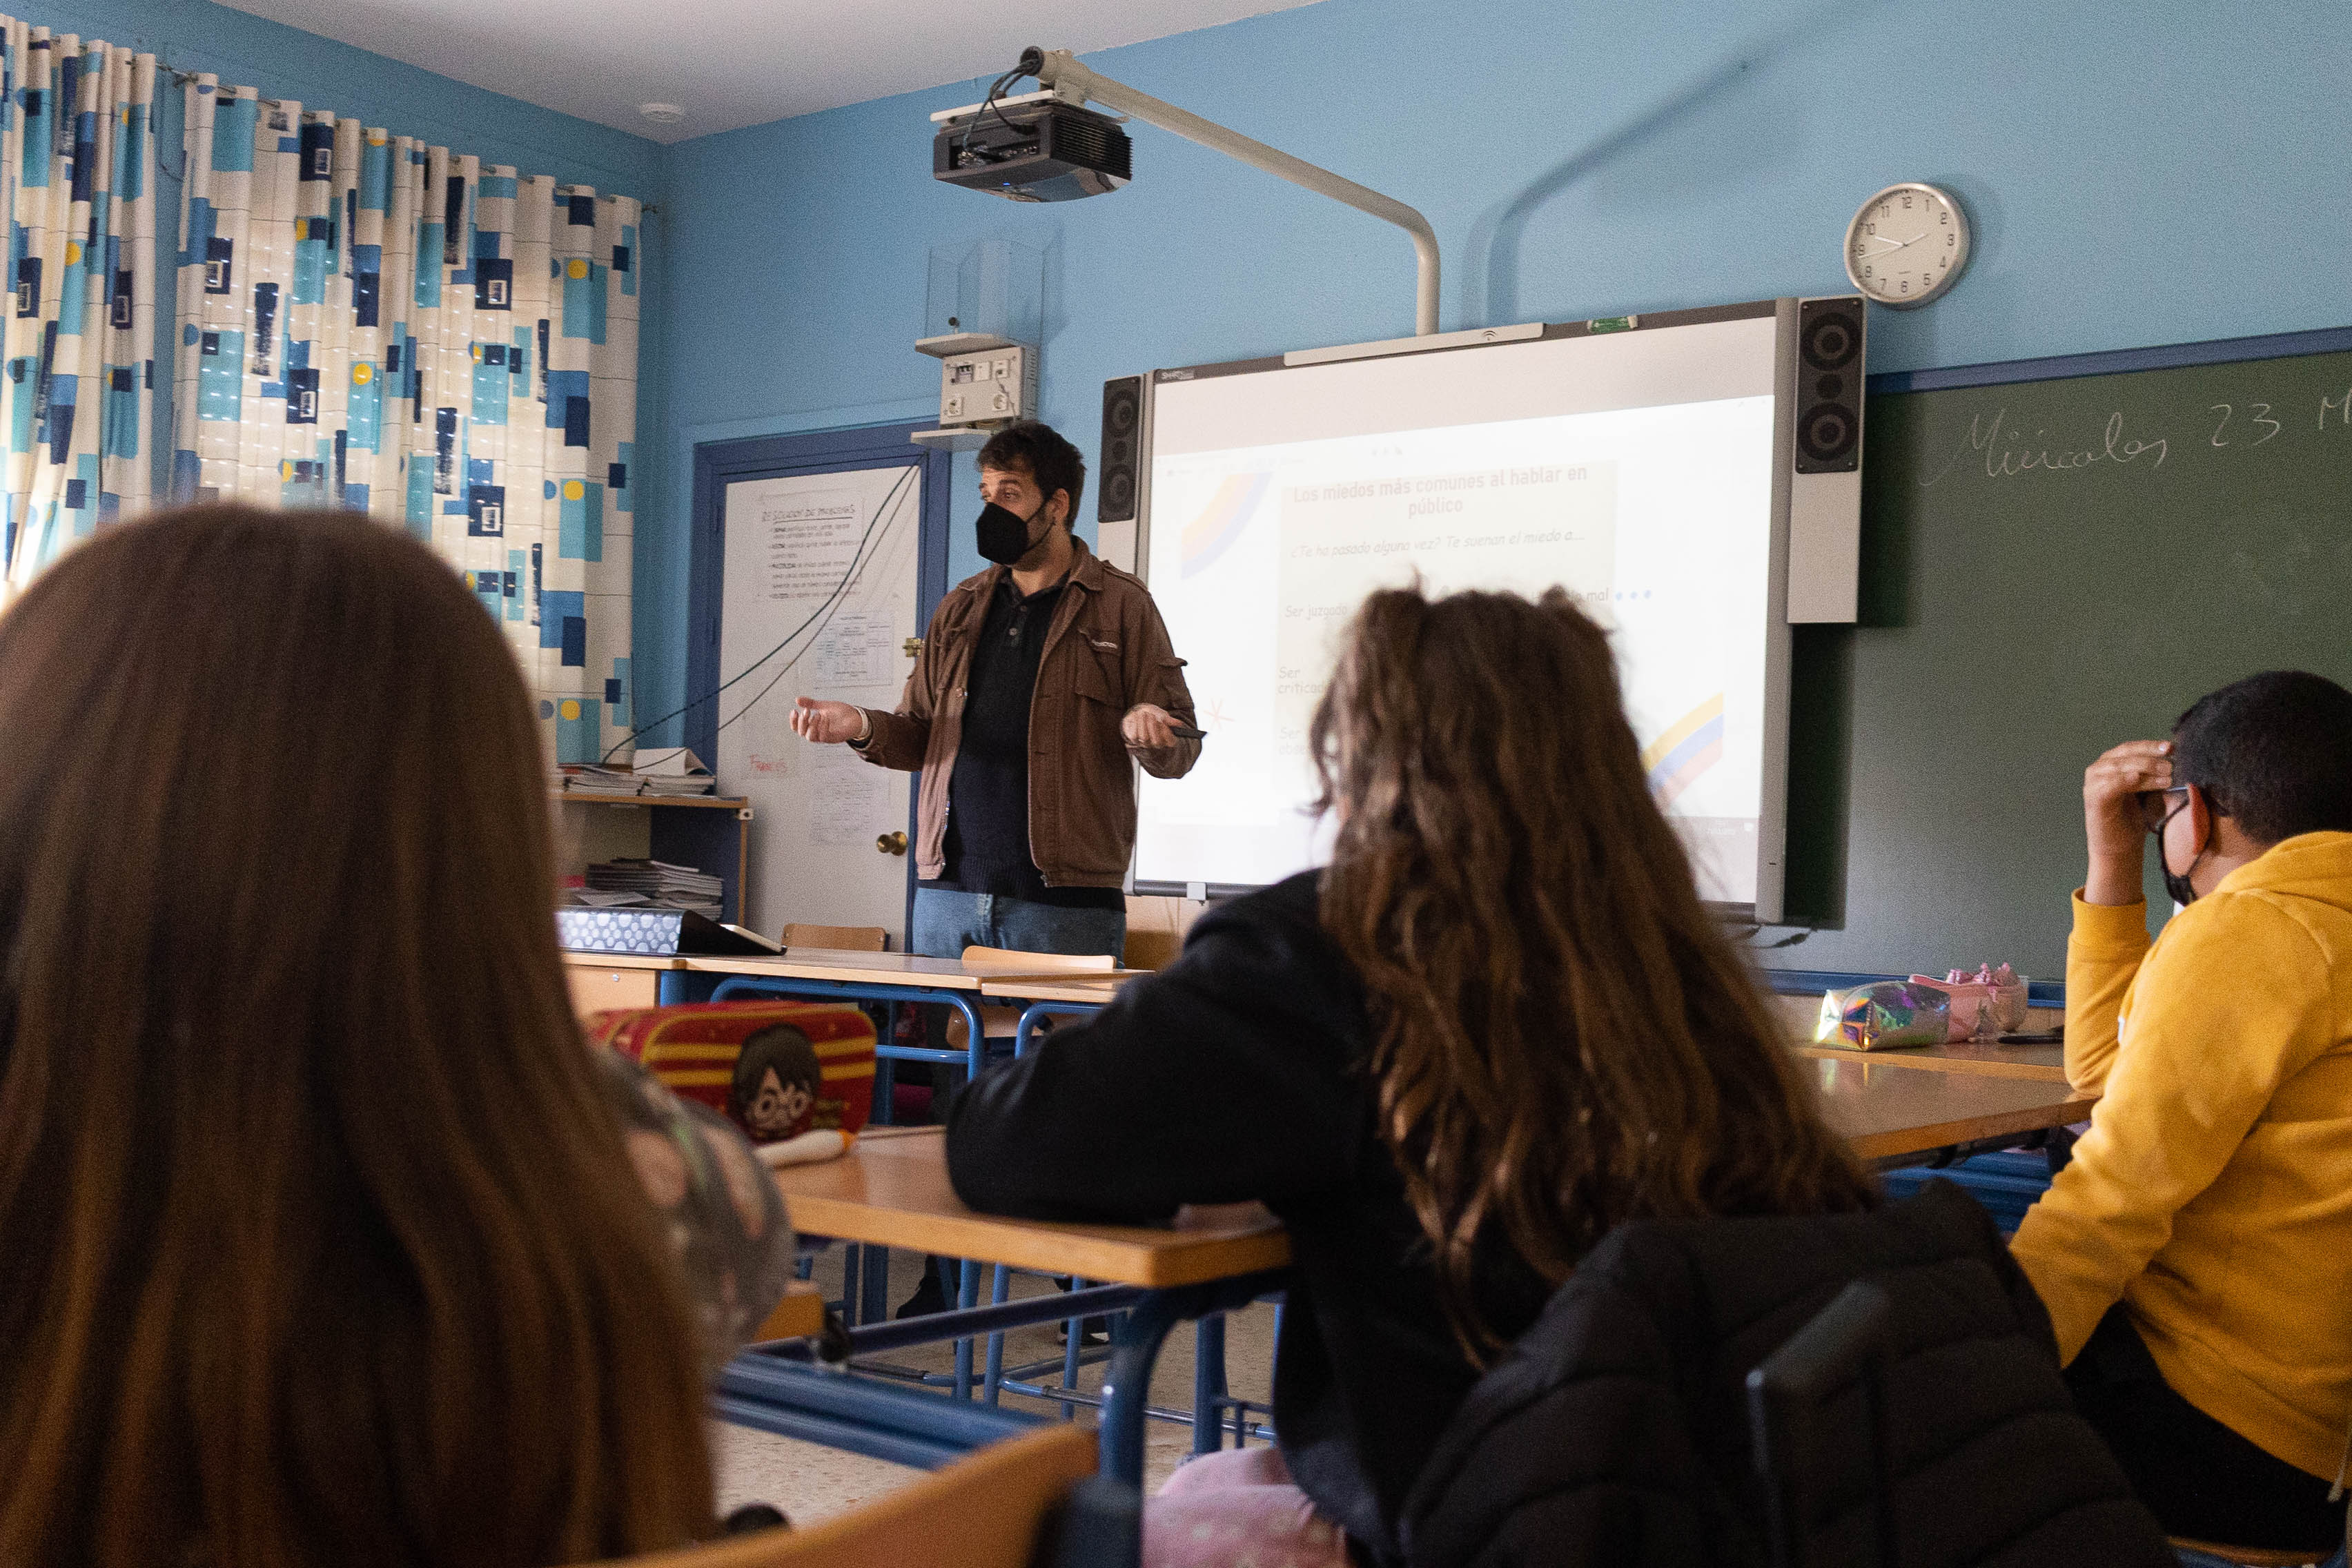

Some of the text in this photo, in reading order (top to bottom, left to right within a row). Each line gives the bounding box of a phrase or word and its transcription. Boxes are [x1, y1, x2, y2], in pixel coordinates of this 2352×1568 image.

[1901, 196, 1912, 209] 12
[1940, 212, 1948, 225] 2
[1861, 222, 1875, 235] 10
[1948, 233, 1954, 246] 3
[1939, 255, 1946, 268] 4
[1865, 265, 1872, 278] 8
[1879, 278, 1887, 291] 7
[1923, 273, 1931, 286] 5
[1901, 280, 1909, 293] 6
[2210, 402, 2281, 447] 23
[1294, 465, 1588, 504] Los miedos más comunes al hablar en
[1408, 496, 1464, 520] público
[1291, 544, 1313, 559] ¿Te
[1315, 544, 1330, 558] ha
[1331, 542, 1371, 560] pasado
[1373, 539, 1411, 556] alguna
[1415, 536, 1441, 551] vez?
[1447, 535, 1459, 549] Te
[1463, 532, 1506, 548] suenan
[1509, 531, 1520, 545] el
[1524, 528, 1562, 544] miedo
[1586, 587, 1609, 602] mal
[1285, 603, 1348, 621] Ser juzgado
[1279, 666, 1301, 679] Ser
